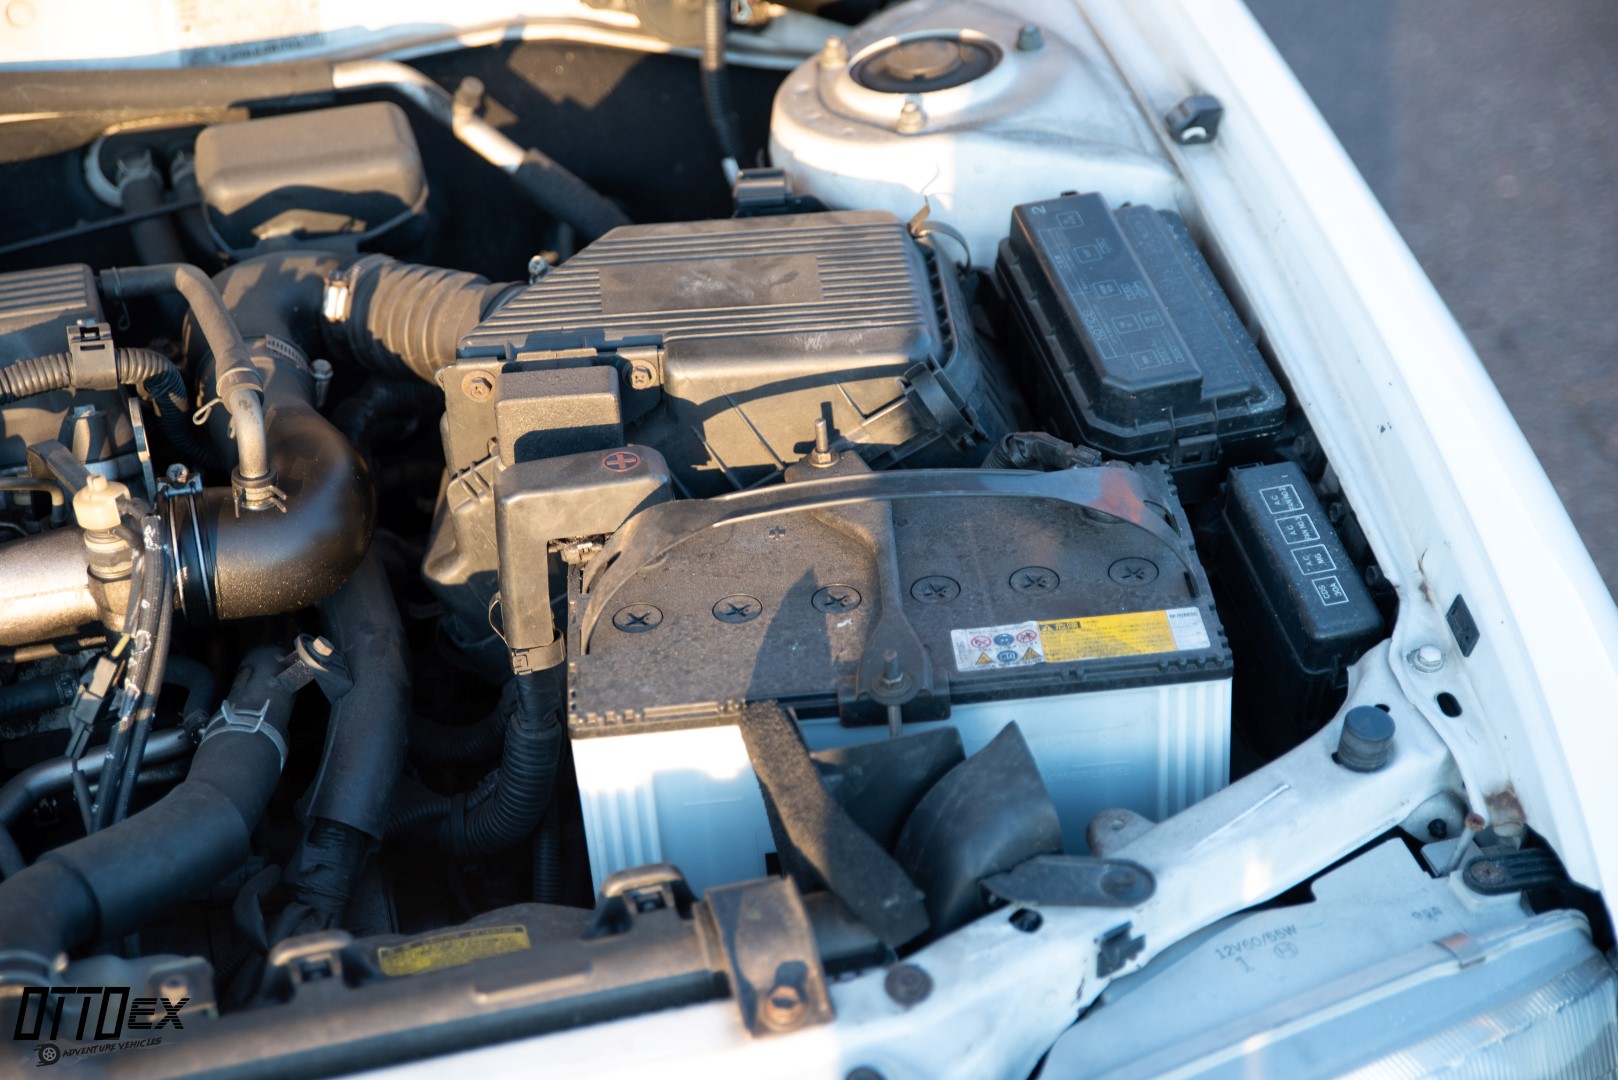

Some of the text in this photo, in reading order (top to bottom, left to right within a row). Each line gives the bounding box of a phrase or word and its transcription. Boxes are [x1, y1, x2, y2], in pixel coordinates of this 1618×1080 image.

[1031, 204, 1047, 215] 2
[1285, 498, 1296, 511] FAN
[1301, 527, 1312, 541] FAN
[1314, 552, 1325, 564] MG
[1318, 584, 1331, 600] CDS
[1330, 582, 1342, 597] 30A
